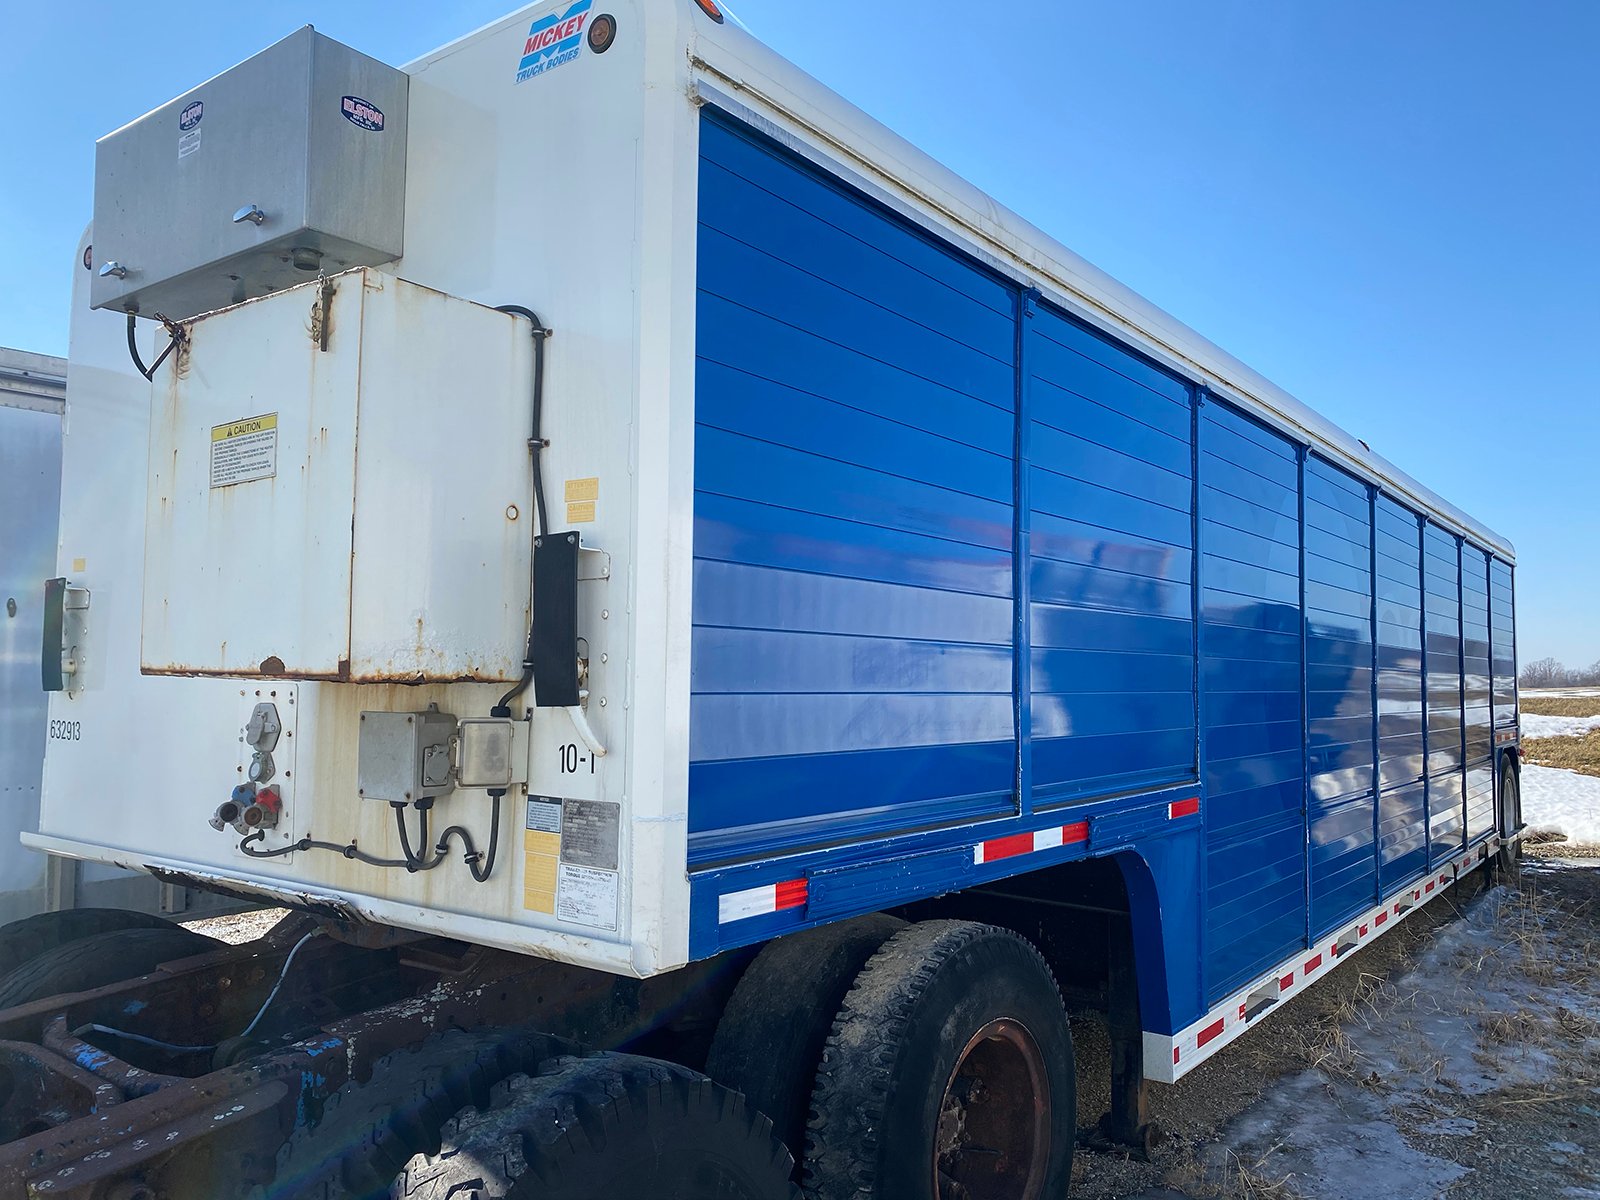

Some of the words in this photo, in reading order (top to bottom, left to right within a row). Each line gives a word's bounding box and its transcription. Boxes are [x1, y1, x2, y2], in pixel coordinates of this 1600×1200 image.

[523, 12, 588, 55] MICKEY
[516, 62, 545, 82] TRUCK
[546, 47, 579, 70] BODIES
[344, 98, 383, 125] ELSTON
[233, 421, 261, 436] CAUTION
[50, 719, 81, 741] 632913
